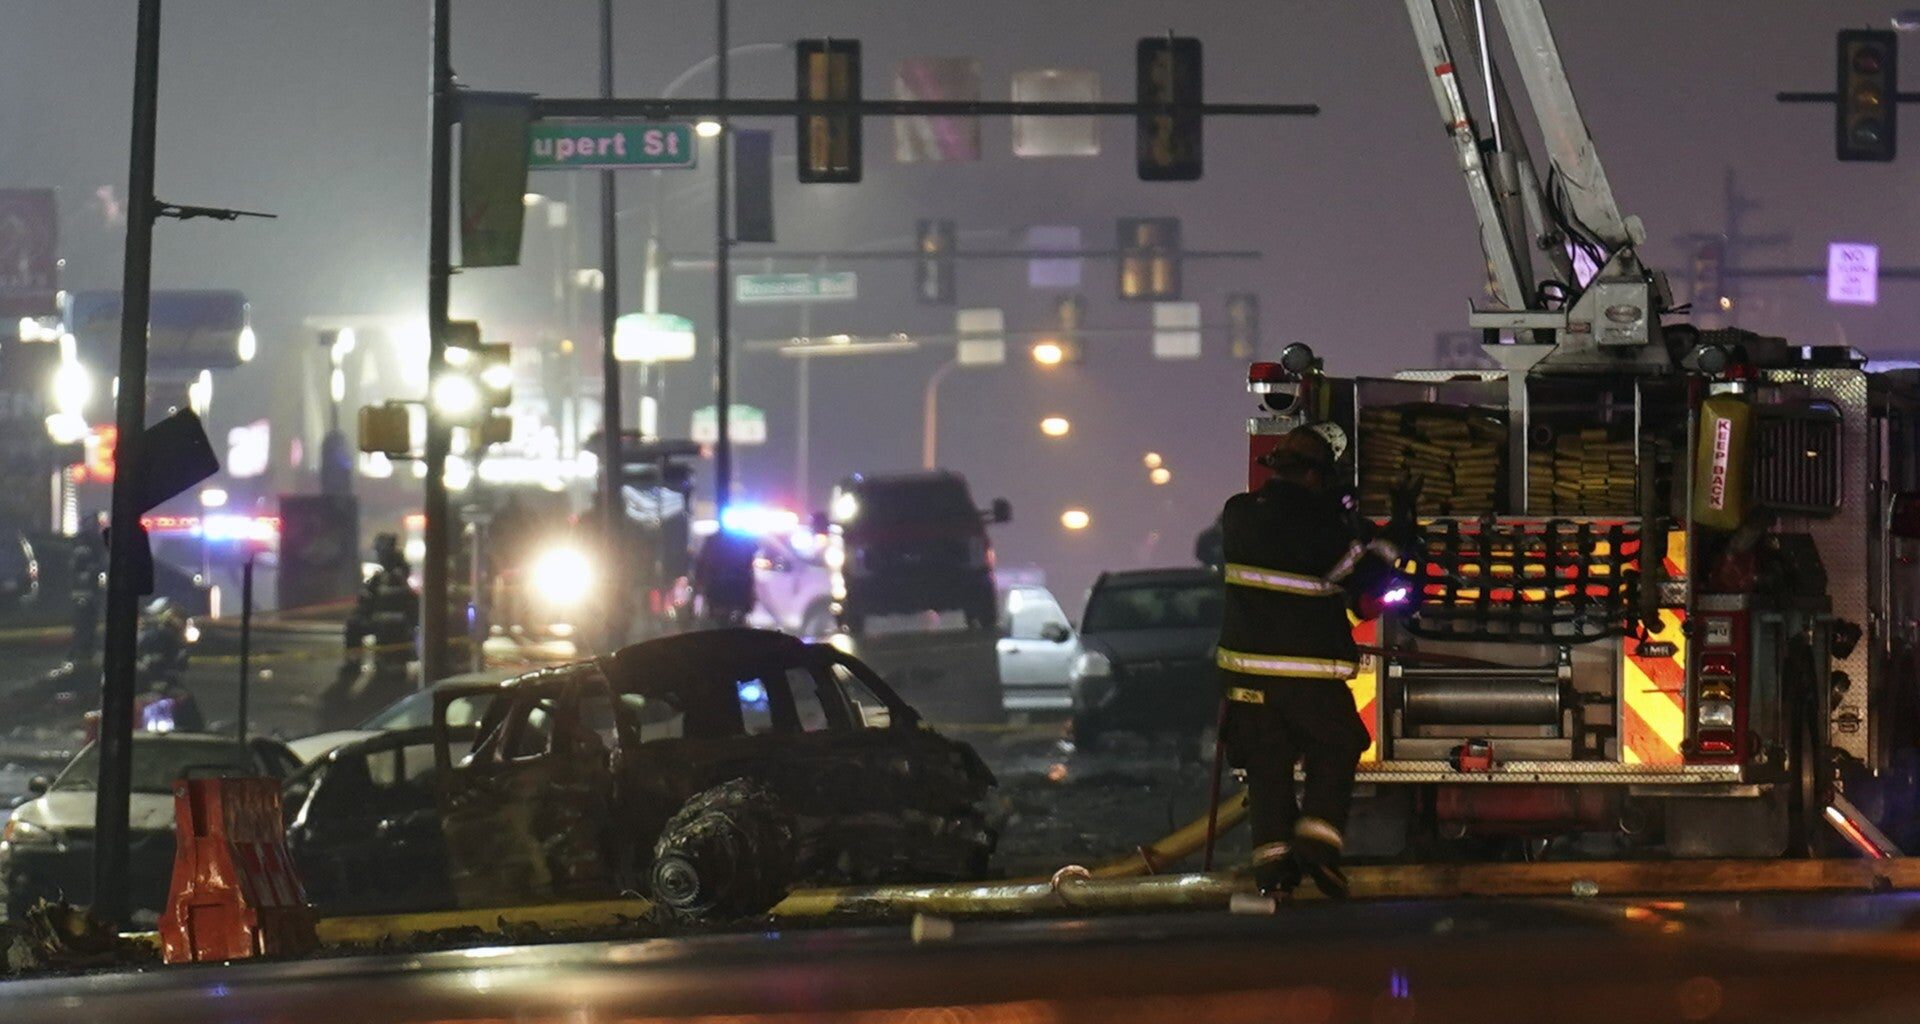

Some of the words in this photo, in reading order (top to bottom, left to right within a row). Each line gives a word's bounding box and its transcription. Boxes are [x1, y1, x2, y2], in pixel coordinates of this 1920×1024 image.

[532, 131, 626, 162] upert
[643, 129, 679, 156] St
[1841, 248, 1866, 261] NO
[1715, 420, 1728, 460] KEEP
[1711, 465, 1724, 505] BACK
